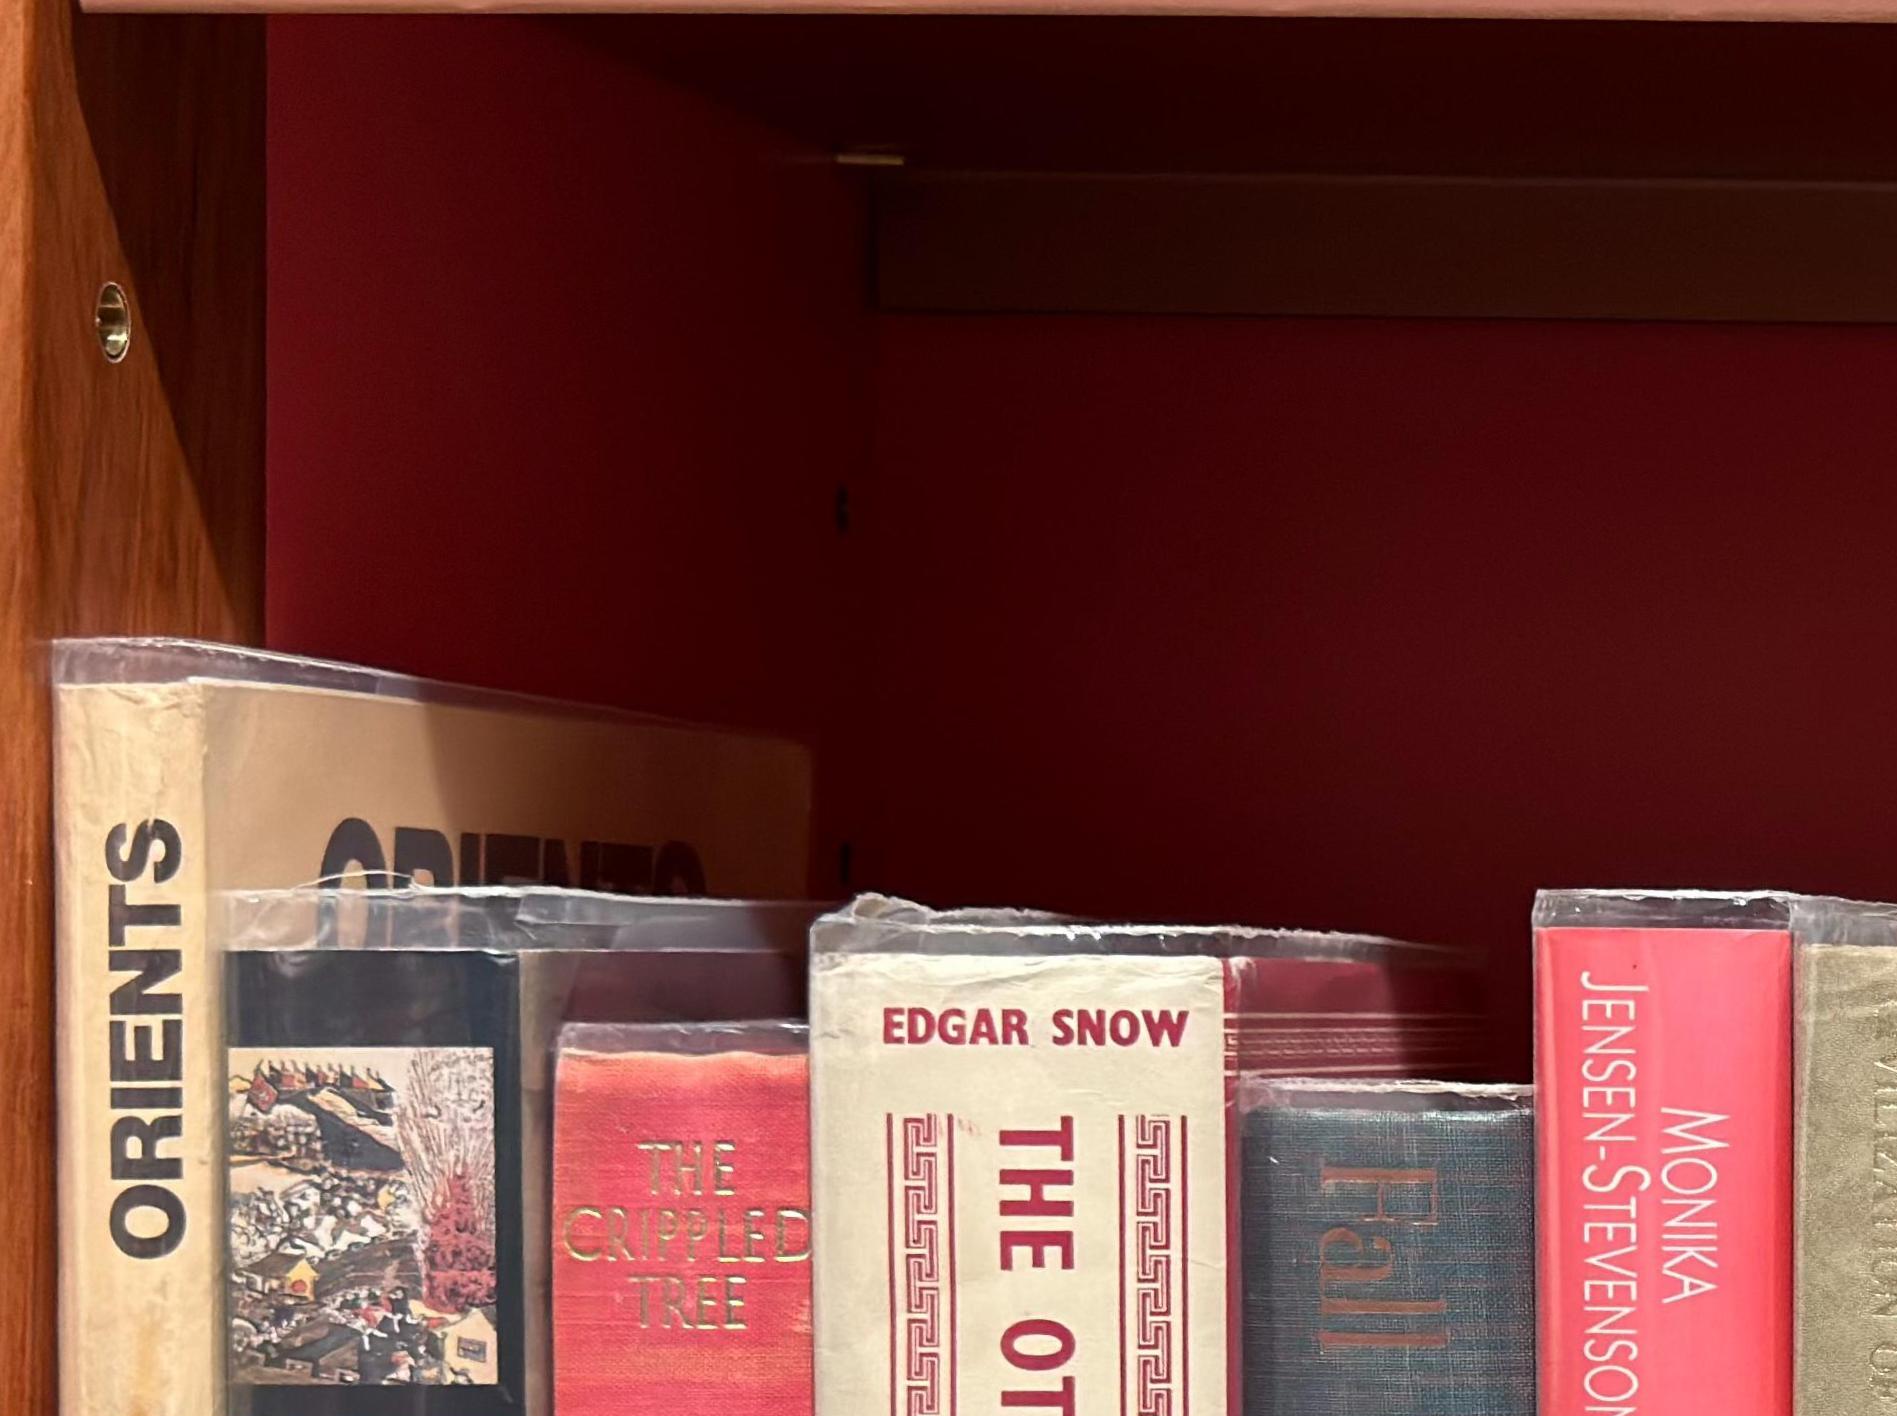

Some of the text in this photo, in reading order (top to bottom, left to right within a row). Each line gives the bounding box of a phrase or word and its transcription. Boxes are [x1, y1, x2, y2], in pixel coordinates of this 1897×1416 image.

[105, 816, 185, 1260] ORIENTS
[883, 1007, 1189, 1047] EDGAR SNOW
[636, 1141, 737, 1198] THE
[999, 1115, 1076, 1272] THE
[1660, 1105, 1730, 1304] MONIKA
[563, 1207, 813, 1265] CRIPPLED
[1319, 1166, 1449, 1353] Fall
[629, 1276, 746, 1331] TREE
